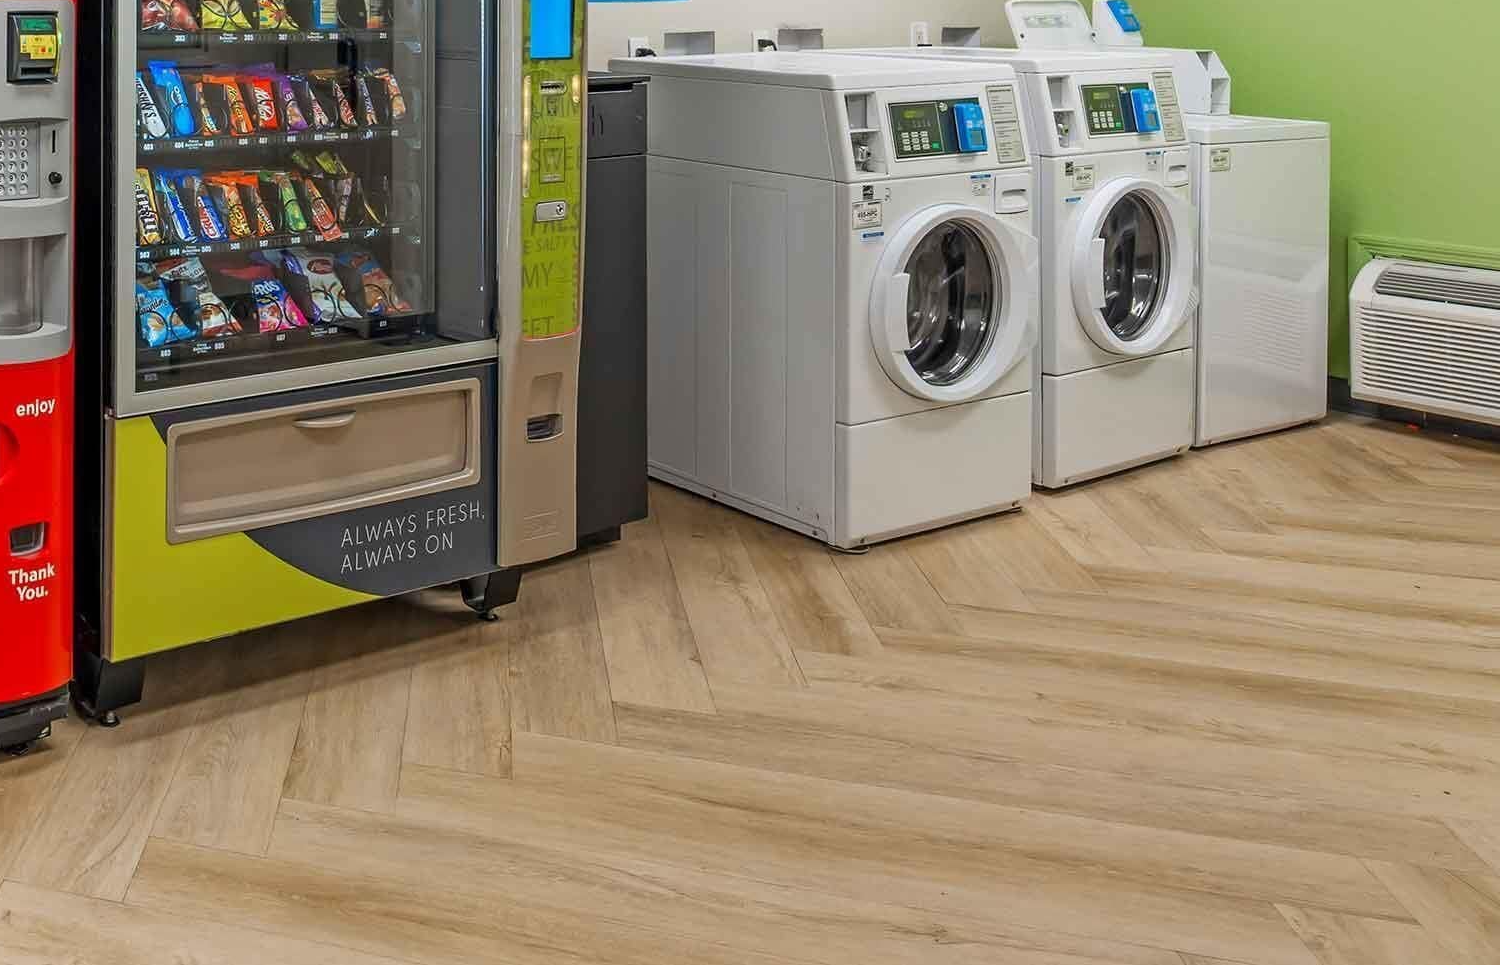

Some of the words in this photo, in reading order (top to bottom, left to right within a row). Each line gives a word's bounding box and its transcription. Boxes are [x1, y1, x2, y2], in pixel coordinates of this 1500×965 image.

[16, 397, 56, 419] enjoy
[341, 514, 417, 548] ALWAYS
[341, 539, 417, 574] ALWAYS
[425, 531, 453, 554] ON
[8, 563, 55, 586] Thank
[17, 585, 49, 603] You.
